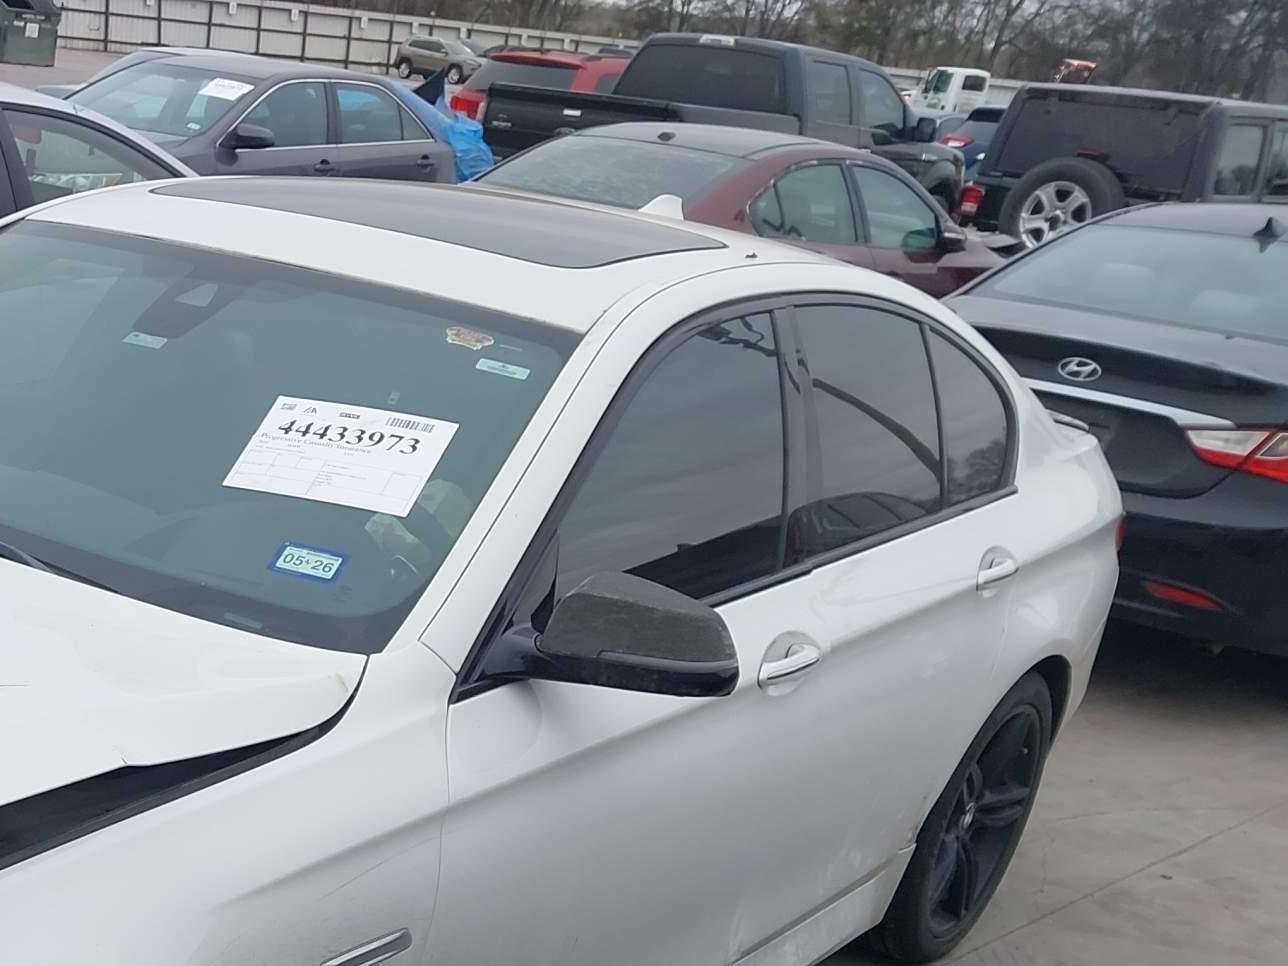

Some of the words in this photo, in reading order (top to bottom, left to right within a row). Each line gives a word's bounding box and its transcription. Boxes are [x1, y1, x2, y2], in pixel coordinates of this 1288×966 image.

[278, 419, 421, 455] 44433973
[283, 553, 306, 567] 05
[311, 560, 335, 573] 26
